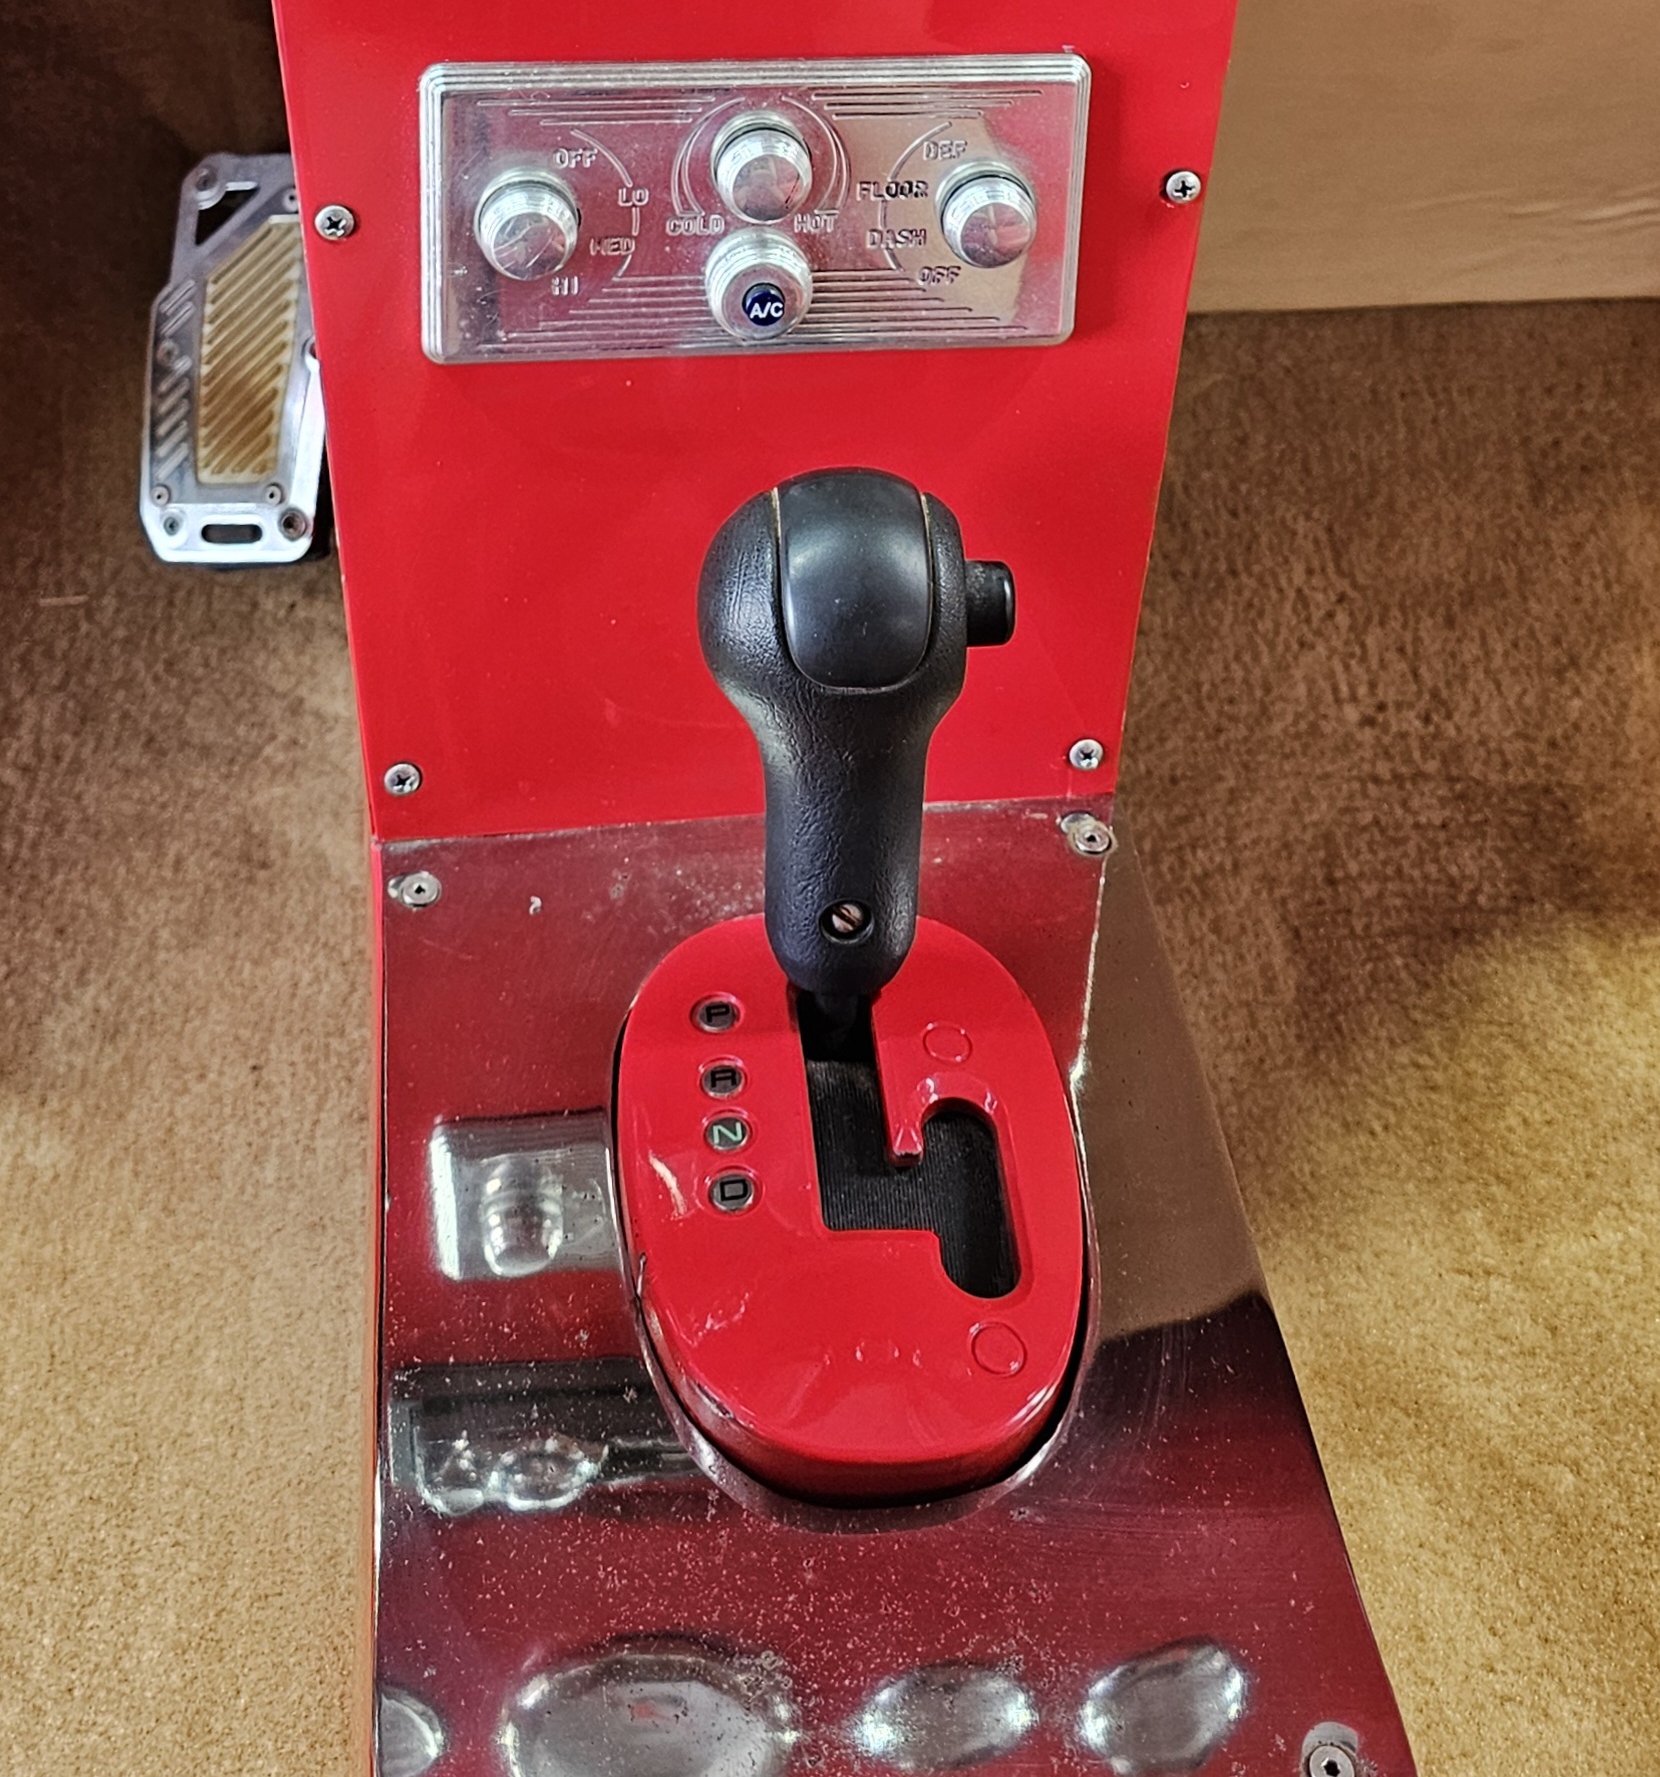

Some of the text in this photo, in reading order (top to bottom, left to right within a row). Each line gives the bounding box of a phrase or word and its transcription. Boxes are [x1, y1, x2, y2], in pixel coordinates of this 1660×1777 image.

[553, 148, 598, 169] OFF
[923, 140, 968, 160] DEF
[617, 187, 649, 207] LO
[856, 180, 929, 201] FLOOR
[665, 214, 726, 237] COLD
[793, 212, 837, 233] HOT
[866, 228, 928, 250] DASH
[917, 265, 962, 287] OFF
[749, 301, 784, 319] A/C
[705, 1004, 730, 1023] P
[710, 1068, 737, 1089] R
[712, 1121, 743, 1144] N
[719, 1178, 749, 1202] D
